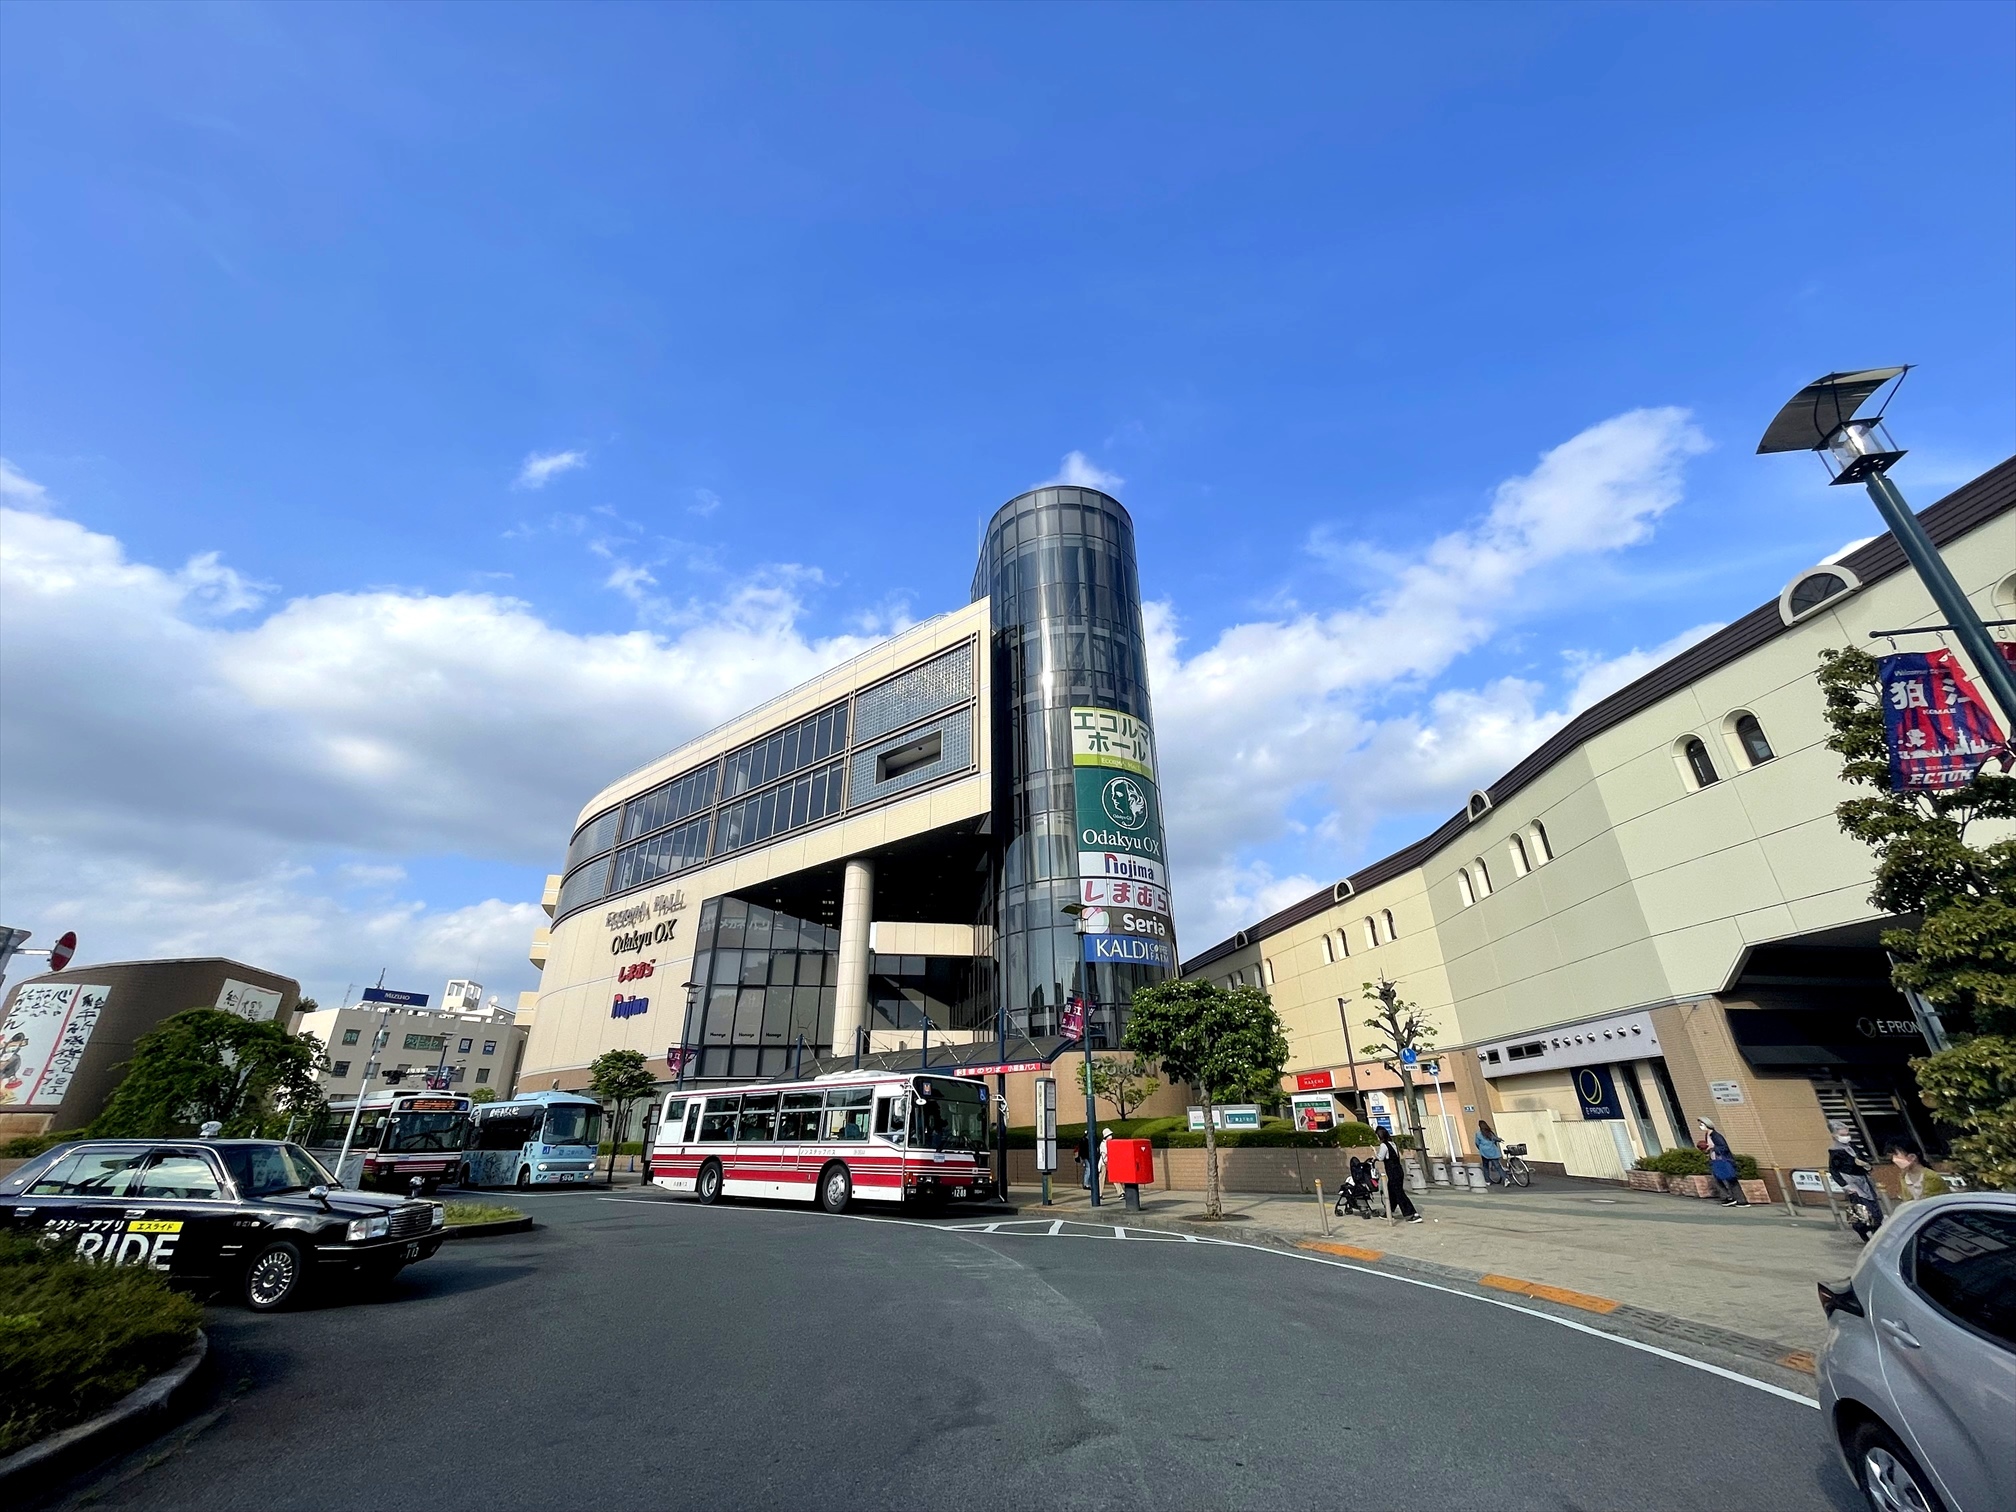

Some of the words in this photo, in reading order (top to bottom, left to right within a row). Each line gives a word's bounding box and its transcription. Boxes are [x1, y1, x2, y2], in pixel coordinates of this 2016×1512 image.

[1074, 712, 1149, 745] エコルマ
[1088, 732, 1146, 762] ホール
[1082, 829, 1141, 851] Odakyu
[1143, 837, 1161, 856] OX
[1084, 881, 1167, 912] しまむら
[611, 930, 653, 955] Odakyu
[654, 919, 678, 944] OX
[1122, 913, 1166, 936] Seria
[1096, 938, 1149, 960] KALDI
[1886, 1020, 1922, 1033] PRON
[45, 1219, 125, 1232] タクシーアプリ
[136, 1223, 174, 1231] エスライド
[37, 1232, 180, 1270] RIDE
